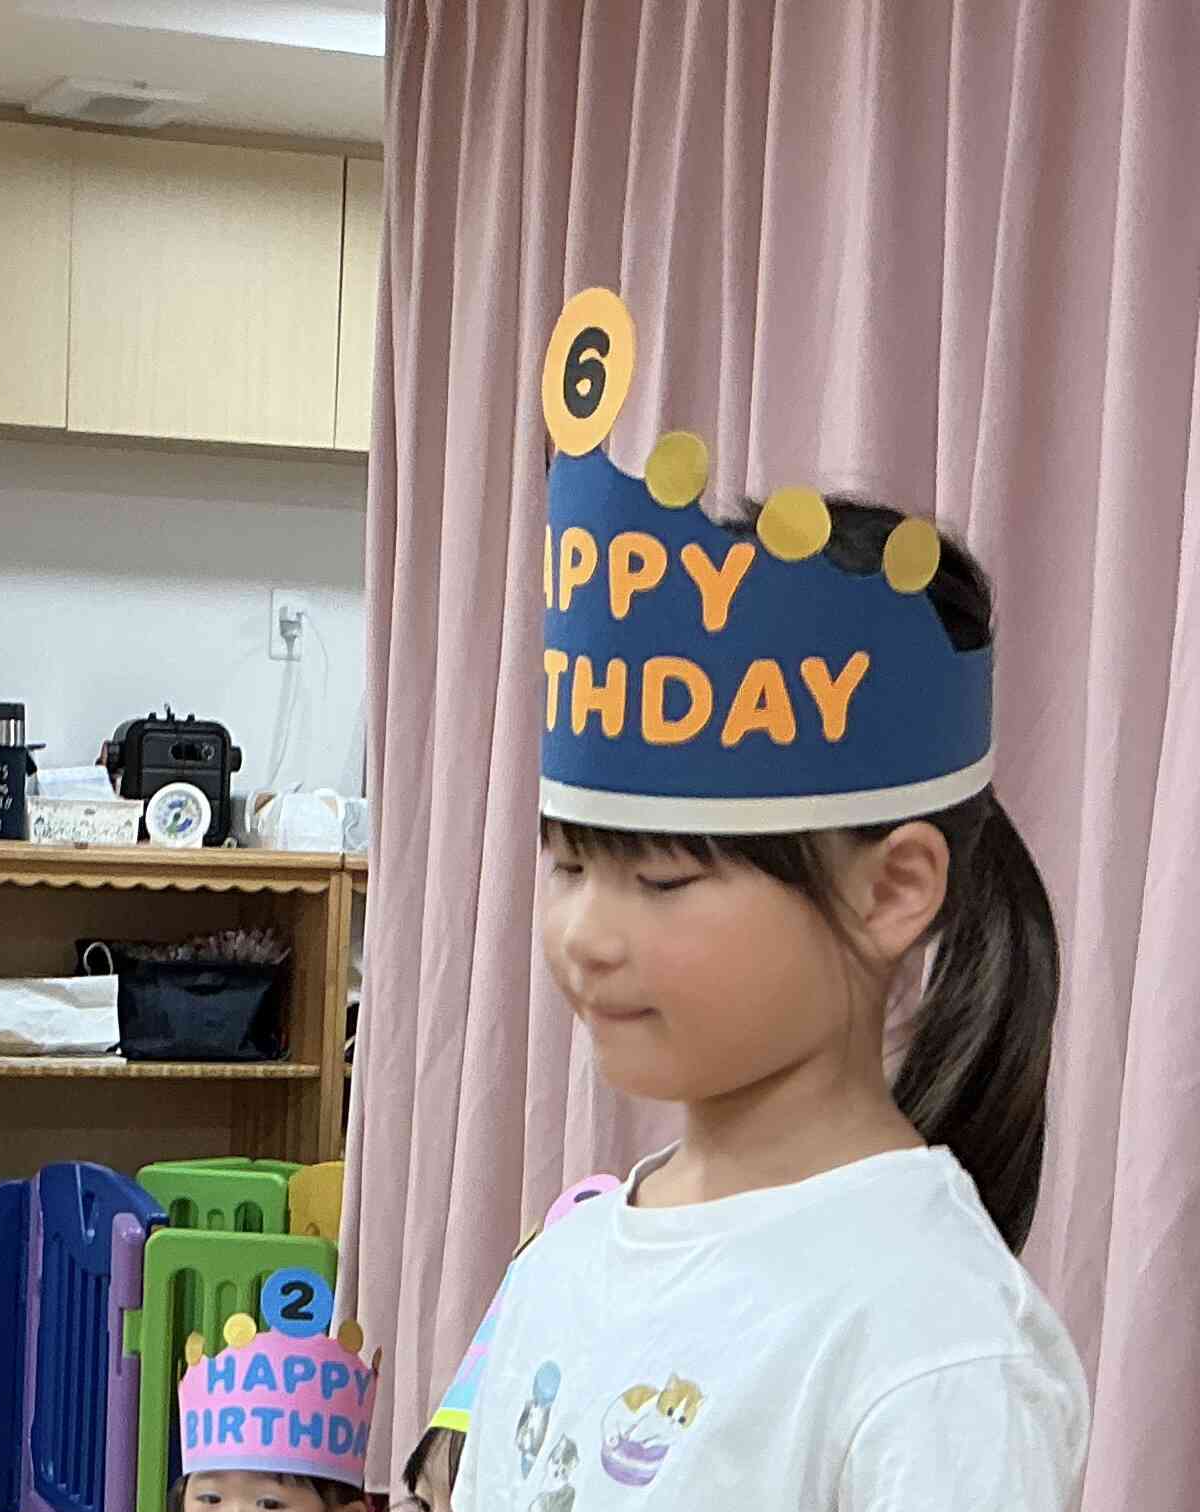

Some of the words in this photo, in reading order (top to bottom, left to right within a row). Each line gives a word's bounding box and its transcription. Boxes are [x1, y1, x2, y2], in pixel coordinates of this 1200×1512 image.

[563, 326, 611, 418] 6
[280, 1281, 315, 1321] 2
[207, 1353, 373, 1406] HAPPY
